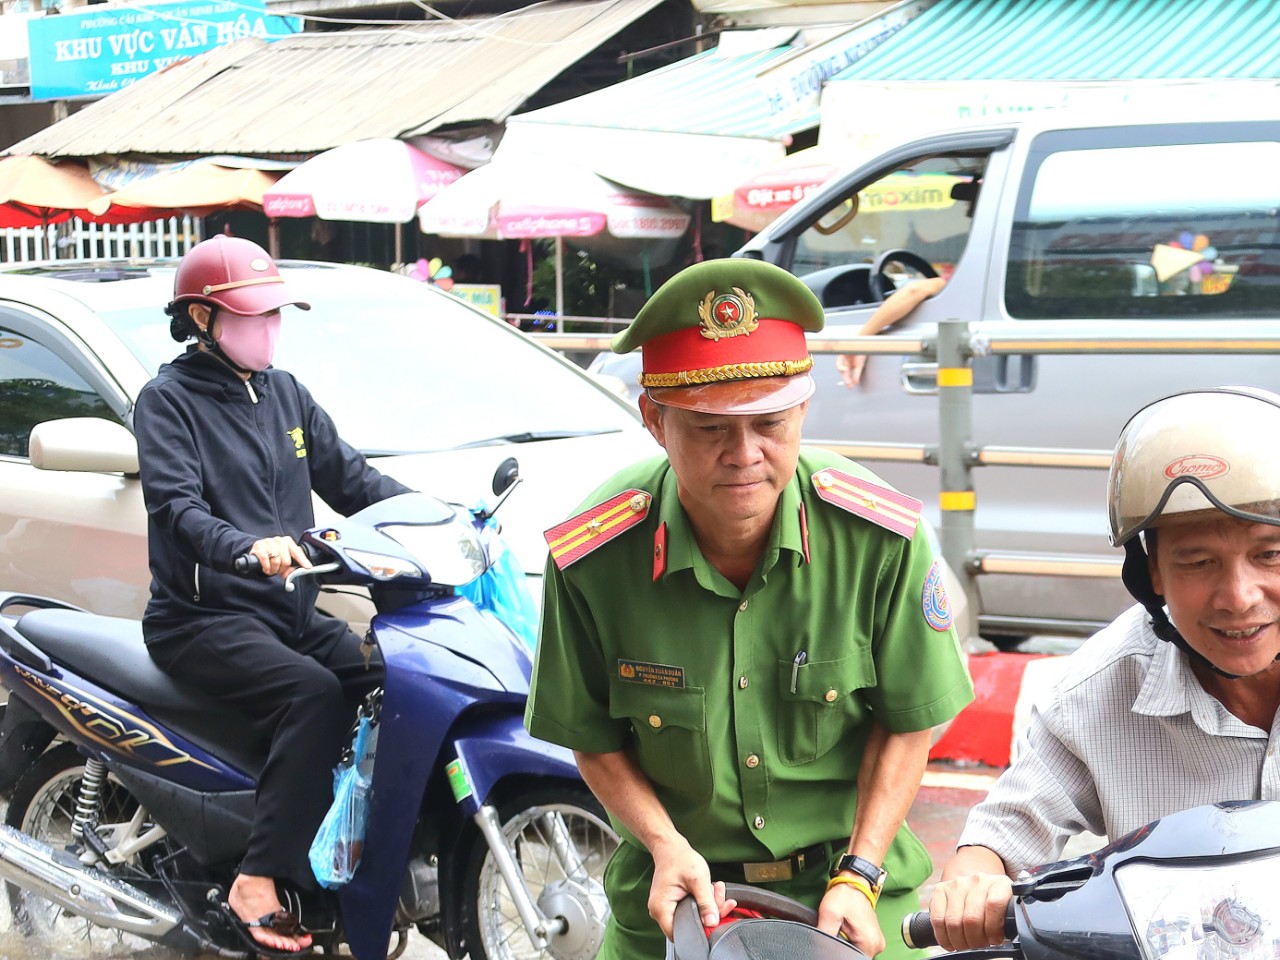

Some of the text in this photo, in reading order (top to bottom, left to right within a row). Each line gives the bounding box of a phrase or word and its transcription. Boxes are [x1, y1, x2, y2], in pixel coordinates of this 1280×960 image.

[54, 12, 270, 62] KHU VỰC VĂN HÓA
[110, 59, 149, 76] KHU
